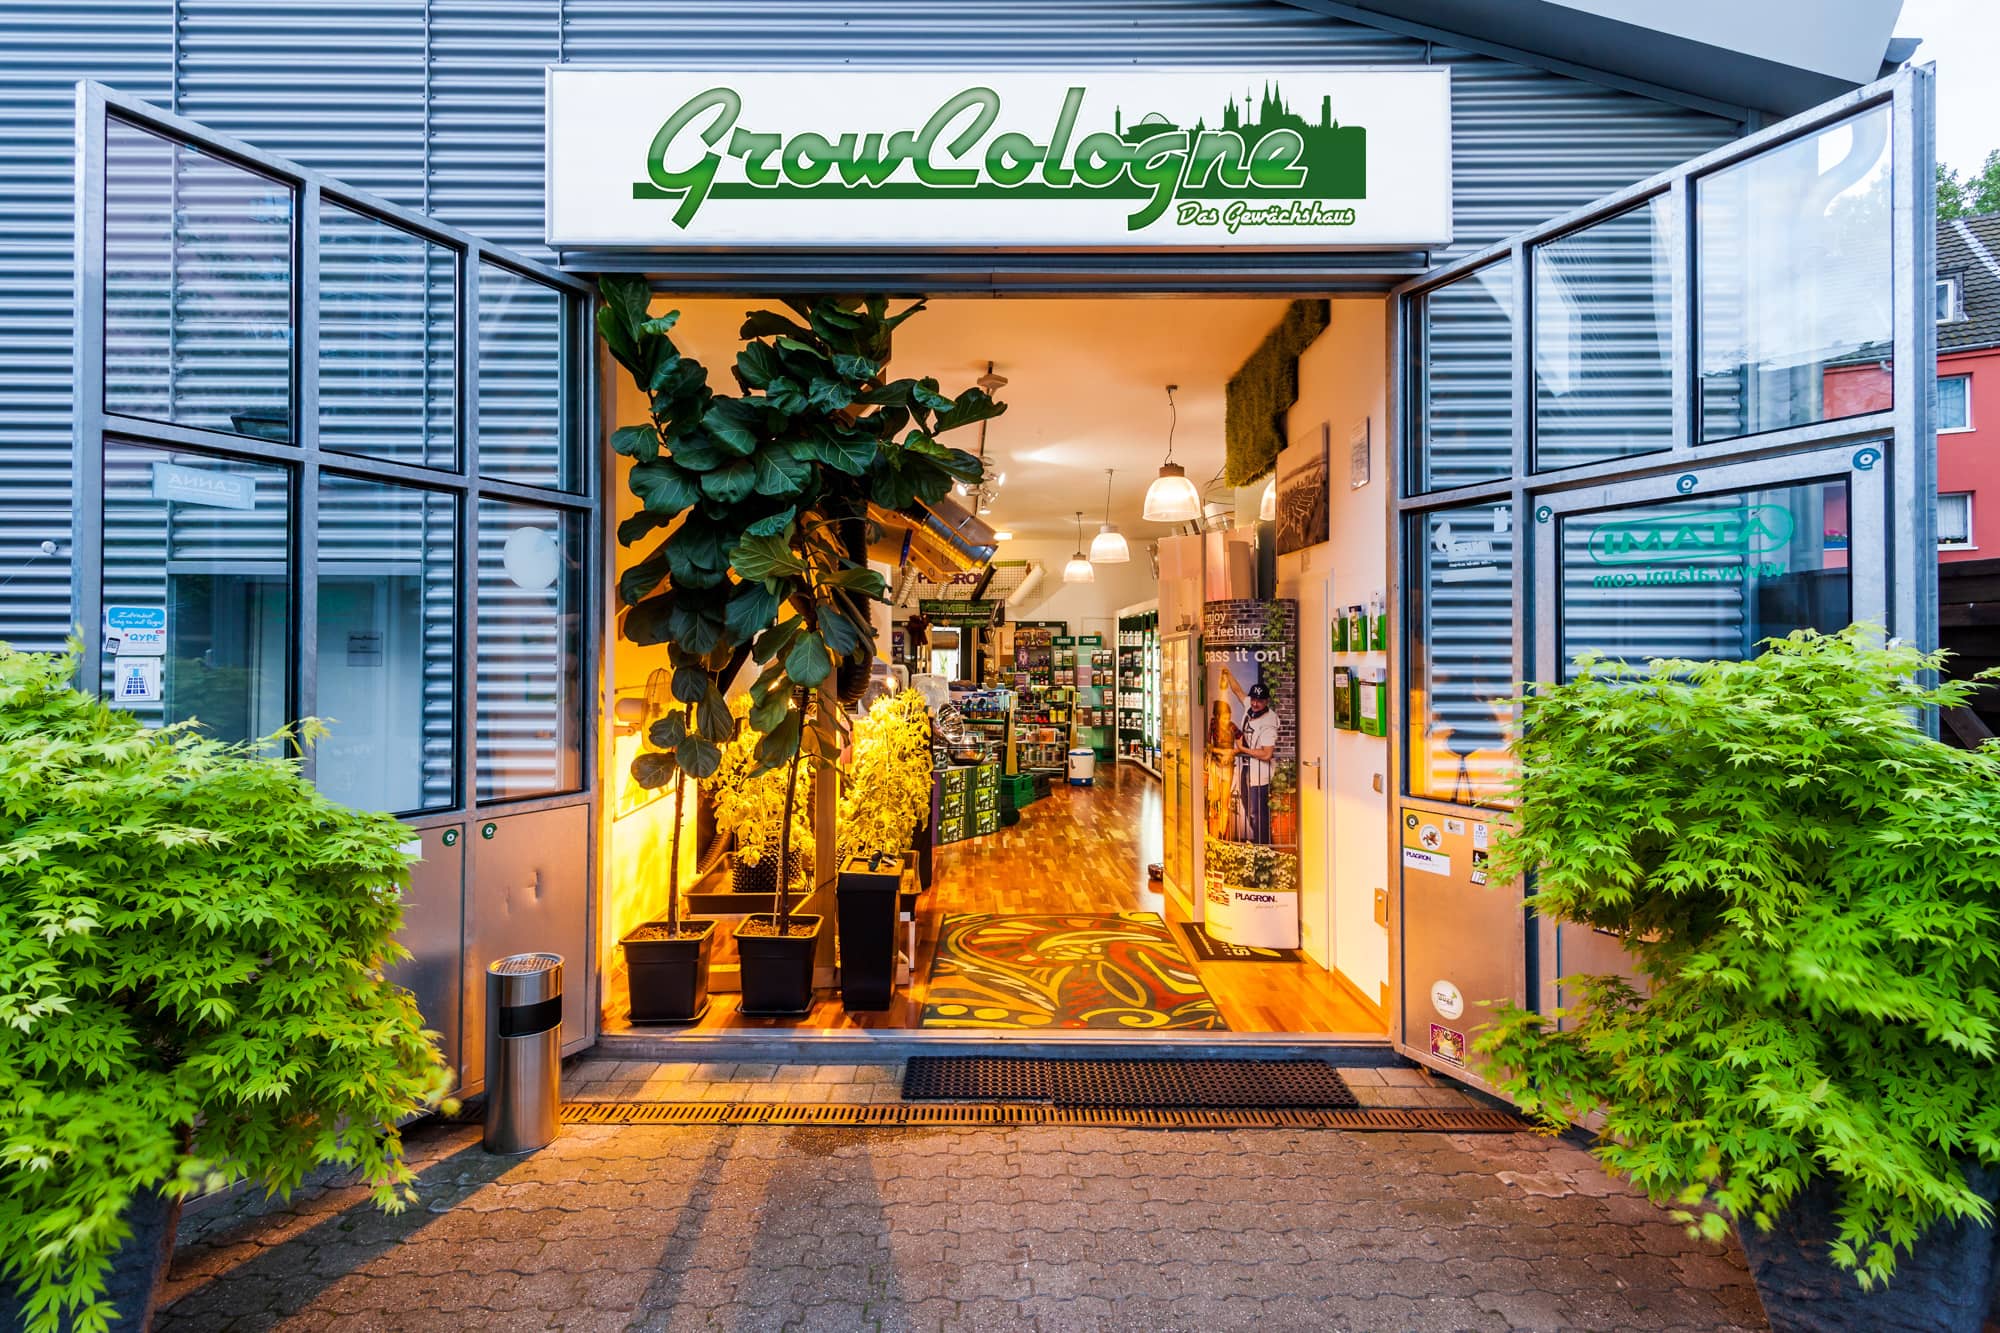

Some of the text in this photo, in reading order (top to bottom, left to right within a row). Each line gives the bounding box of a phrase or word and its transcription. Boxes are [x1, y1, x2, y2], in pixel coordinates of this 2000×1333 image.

[647, 86, 1308, 231] GrowCologne
[1177, 201, 1356, 235] Das Gewächshaus
[917, 572, 993, 585] PGRO
[129, 633, 160, 642] QYPE
[1217, 624, 1265, 639] feeling.
[1205, 646, 1287, 667] pass it on!
[1235, 892, 1276, 903] PLAGRON
